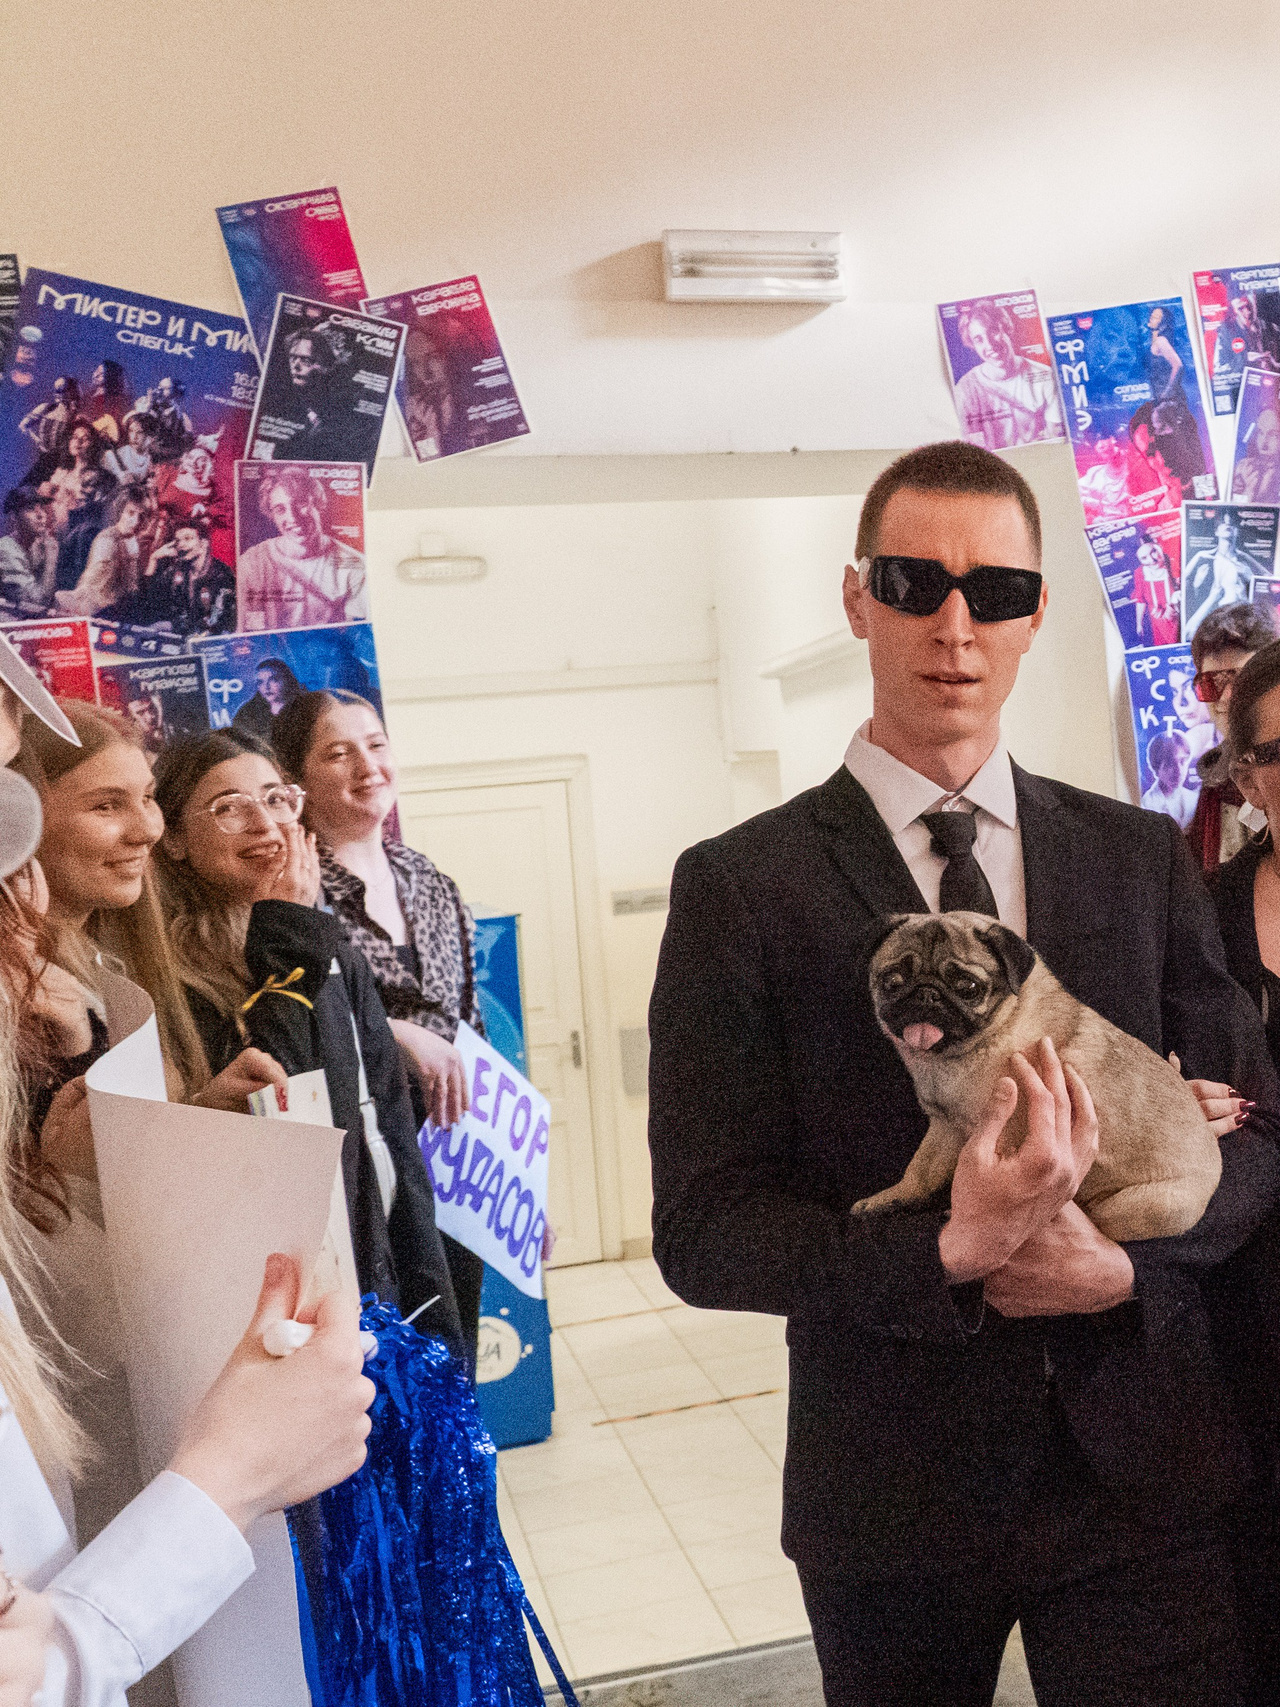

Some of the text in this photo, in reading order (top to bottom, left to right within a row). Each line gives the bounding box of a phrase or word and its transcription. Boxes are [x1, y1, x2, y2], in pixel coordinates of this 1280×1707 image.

[37, 283, 162, 330] МИСТЕР
[167, 315, 187, 339] И
[470, 1057, 549, 1169] ЕГОР
